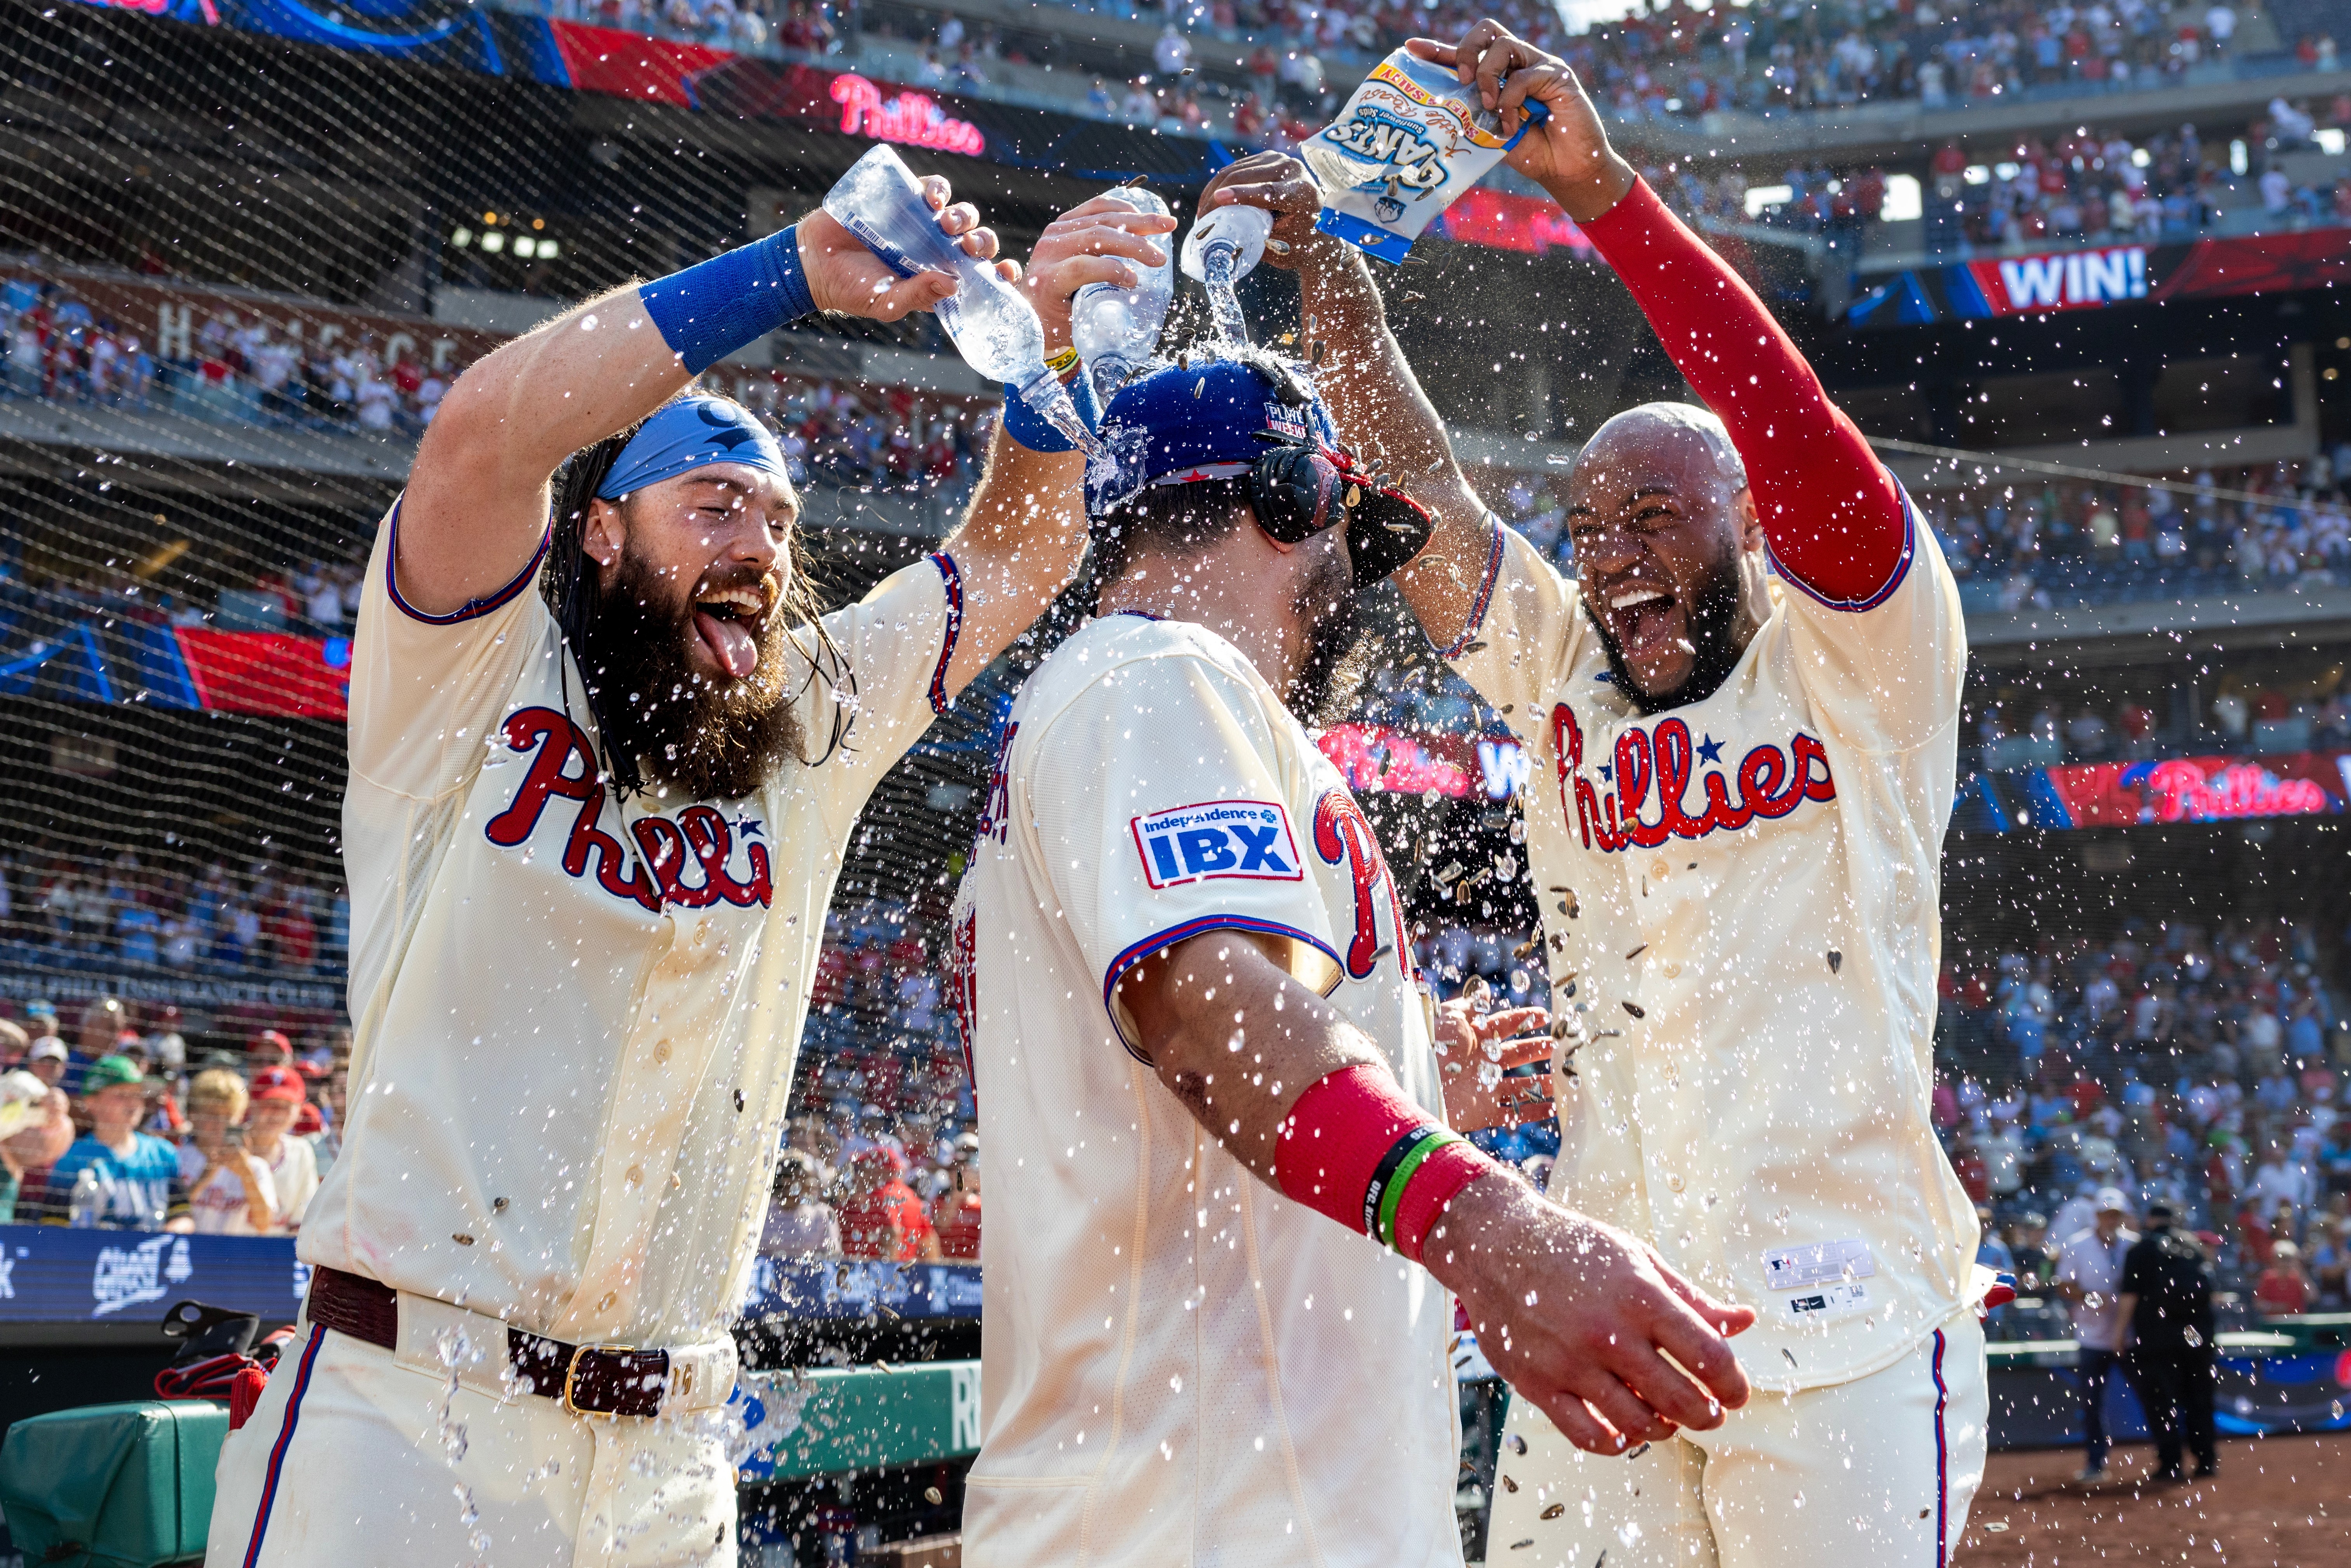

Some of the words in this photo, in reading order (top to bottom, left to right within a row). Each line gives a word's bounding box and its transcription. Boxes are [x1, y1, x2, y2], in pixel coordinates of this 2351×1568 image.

[1379, 68, 1426, 101] SALTY
[1359, 89, 1418, 117] Roast
[1444, 99, 1480, 139] SWEET
[1379, 111, 1425, 134] Sunflower
[1425, 110, 1471, 158] Kettle
[1998, 246, 2148, 309] WIN!
[1270, 406, 1316, 426] PLAYE
[1554, 702, 1837, 853] Phillies
[485, 706, 773, 913] Philli
[1144, 808, 1257, 833] Independence
[1149, 825, 1292, 880] IBX
[1366, 1180, 1382, 1204] OFC.
